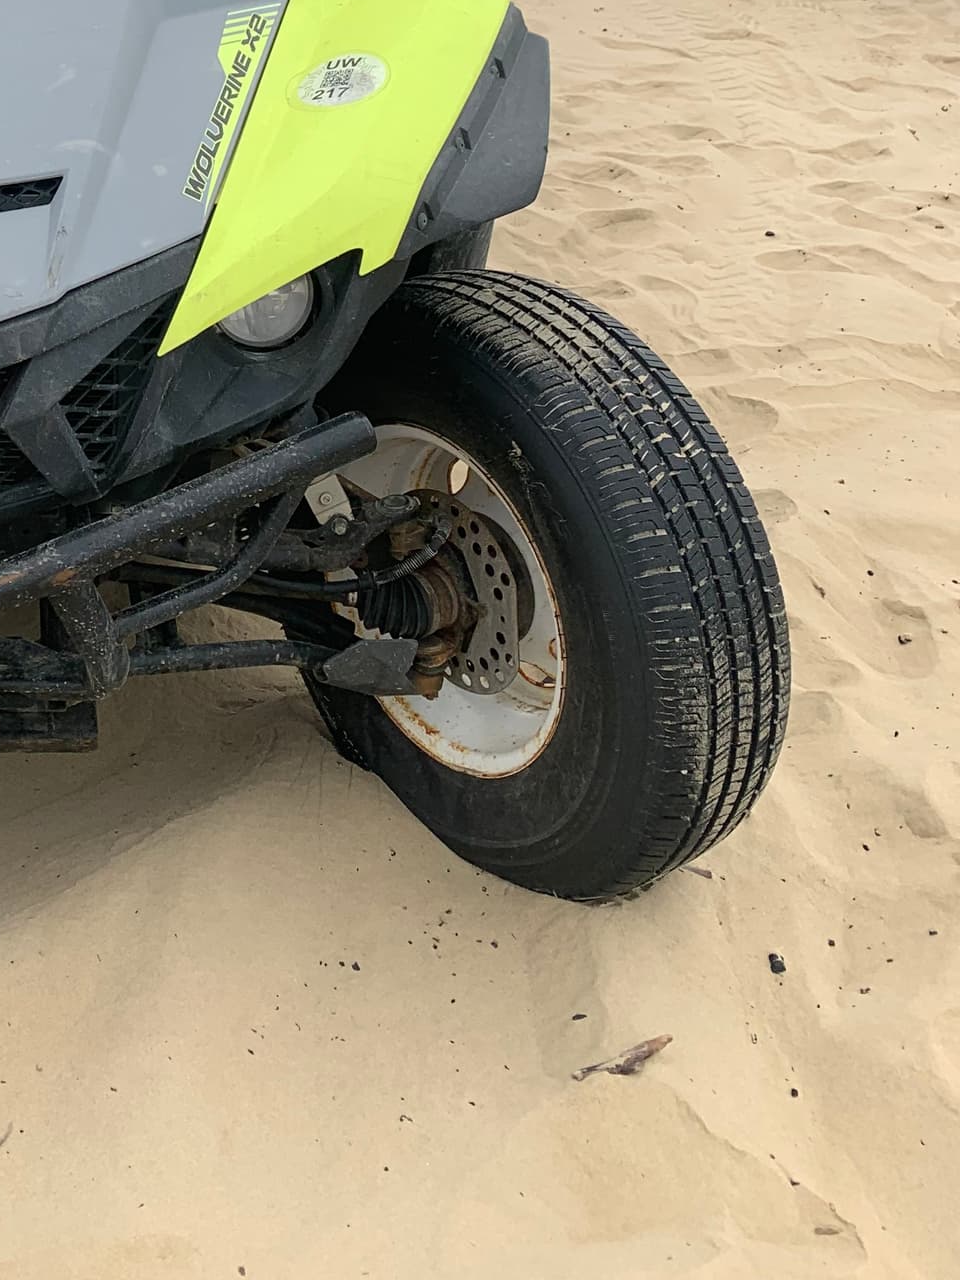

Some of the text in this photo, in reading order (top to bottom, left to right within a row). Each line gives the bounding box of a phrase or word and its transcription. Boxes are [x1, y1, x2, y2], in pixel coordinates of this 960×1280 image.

[326, 56, 362, 70] UW
[311, 86, 350, 101] 217
[184, 13, 268, 201] WOLVERINE X2
